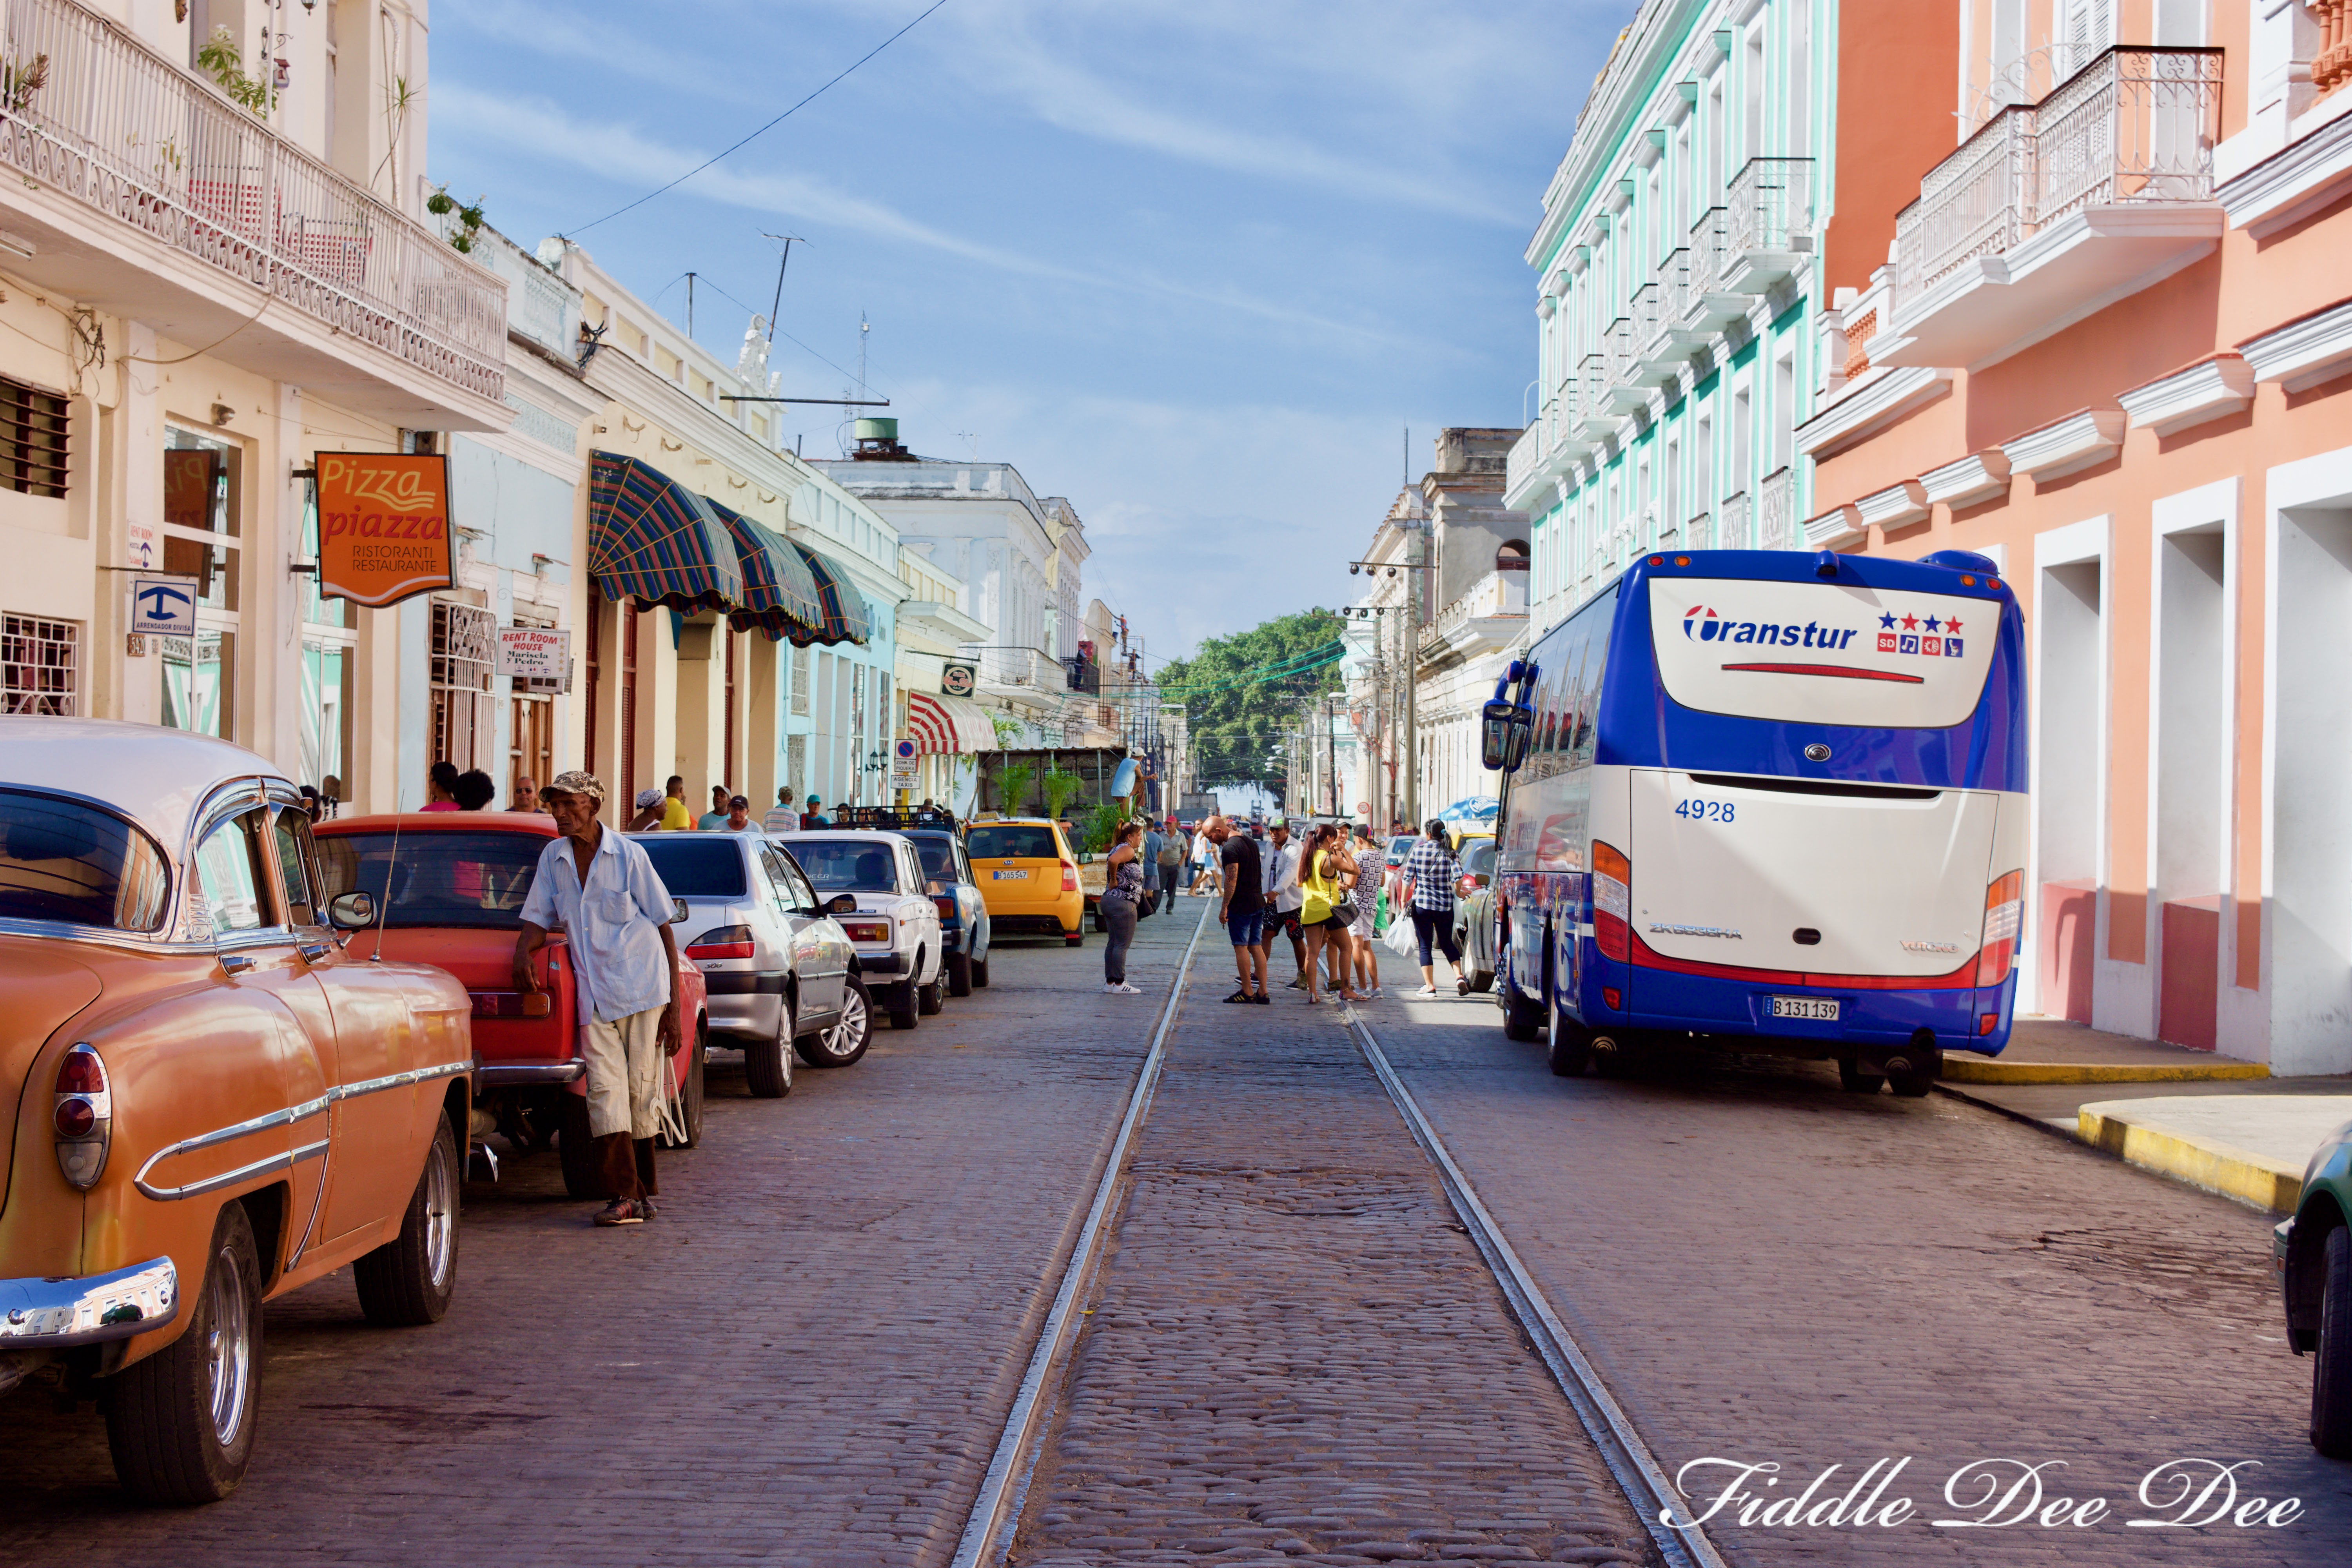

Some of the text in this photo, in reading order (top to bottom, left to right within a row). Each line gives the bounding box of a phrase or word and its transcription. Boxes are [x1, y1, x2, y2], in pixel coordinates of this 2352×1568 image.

[320, 460, 436, 512] Pizza
[323, 505, 443, 546] piazza
[353, 545, 432, 559] RISTORANTI
[353, 559, 437, 572] RESTAURANTE
[136, 622, 172, 630] ARRENDADOR
[502, 632, 558, 644] RENT ROOM
[1879, 638, 1895, 648] SD
[513, 642, 543, 651] HOUSE
[1675, 799, 1735, 823] 4928
[1649, 922, 1742, 940] ZK6838HA
[1899, 940, 1960, 953] YUTONG
[1773, 1000, 1837, 1018] B 131 139
